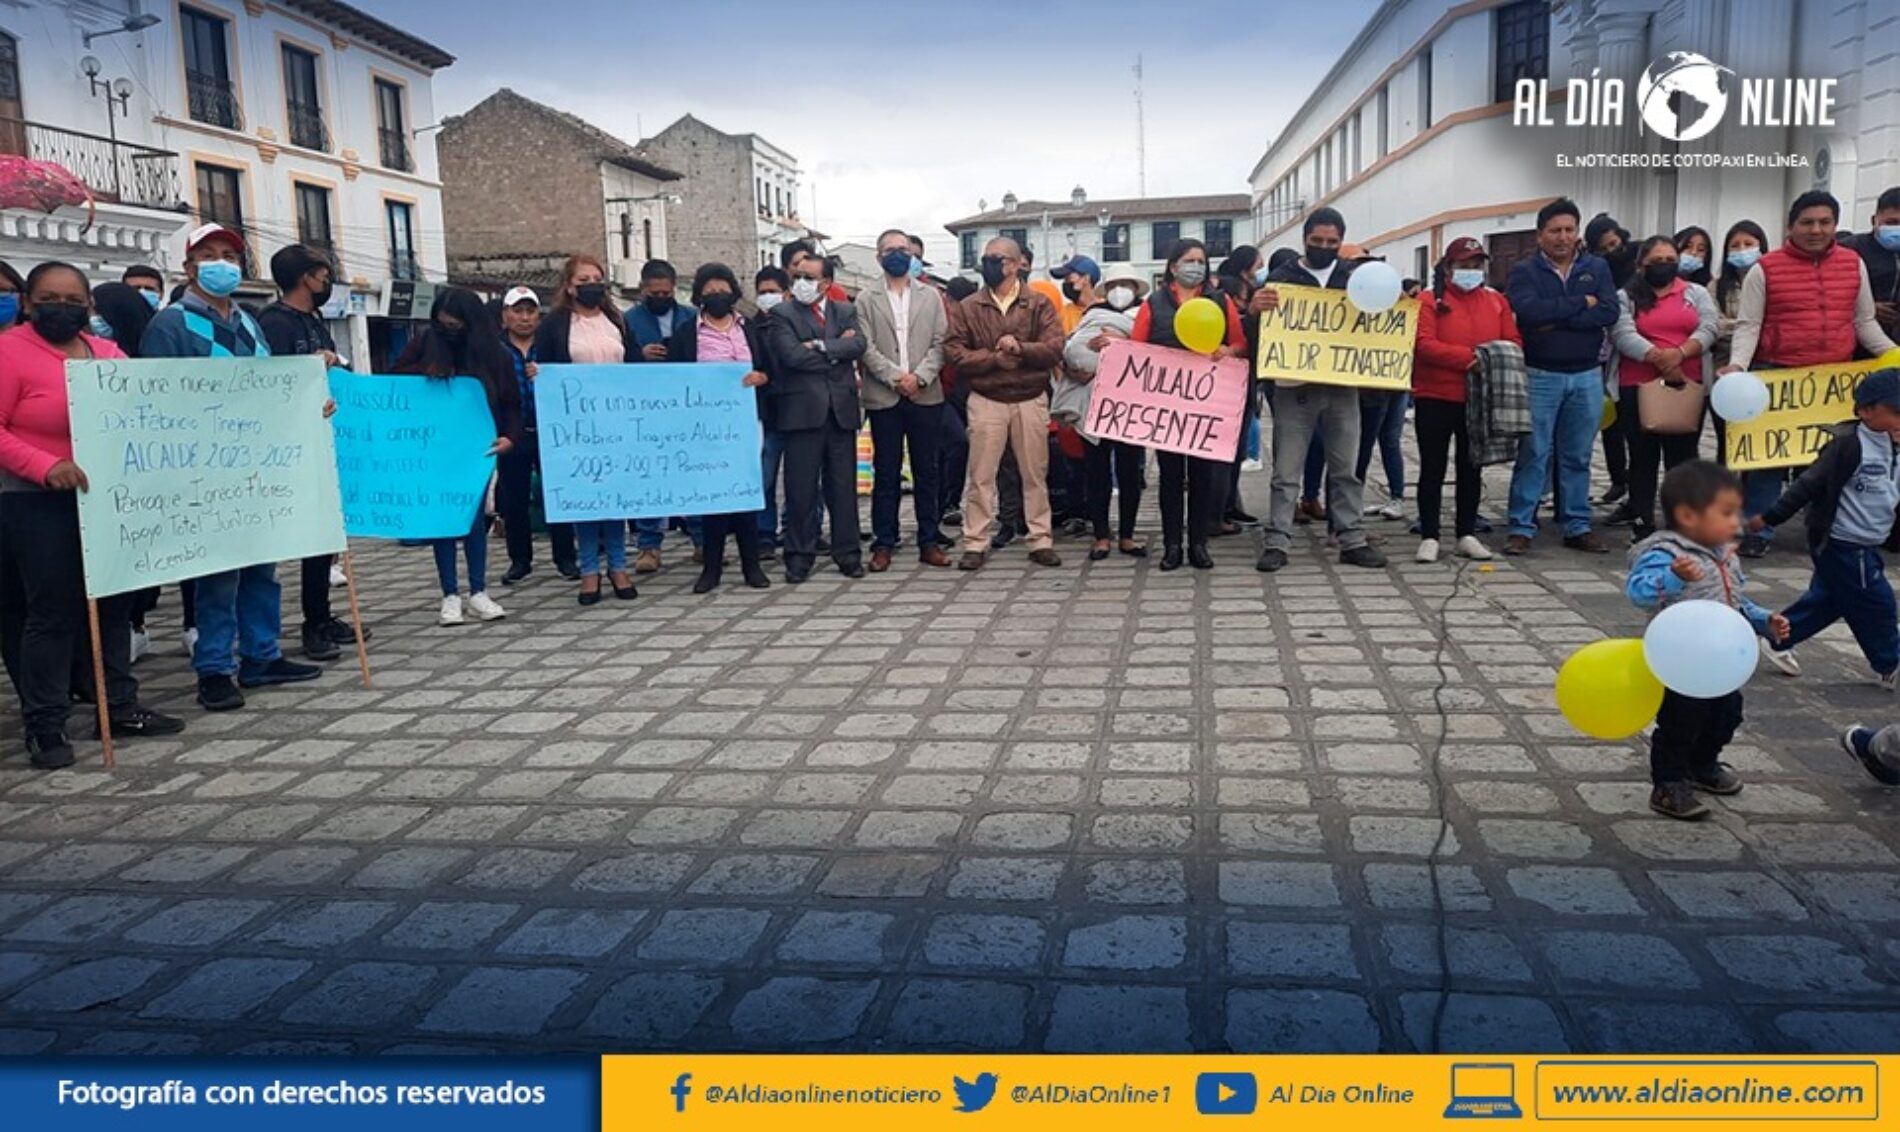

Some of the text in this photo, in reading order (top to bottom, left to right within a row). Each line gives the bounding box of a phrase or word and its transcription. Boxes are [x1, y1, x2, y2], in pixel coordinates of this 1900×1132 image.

[1265, 297, 1346, 333] MULALÓ
[97, 361, 130, 393] Por
[1115, 354, 1218, 401] MULALÓ
[1264, 343, 1412, 381] AL DR TINAJERO
[559, 376, 597, 416] Por
[1766, 371, 1817, 412] LALÓ
[1093, 397, 1225, 453] PRESENTE
[123, 441, 199, 476] ALCALDE
[1733, 433, 1761, 463] AL
[1765, 429, 1791, 460] DR
